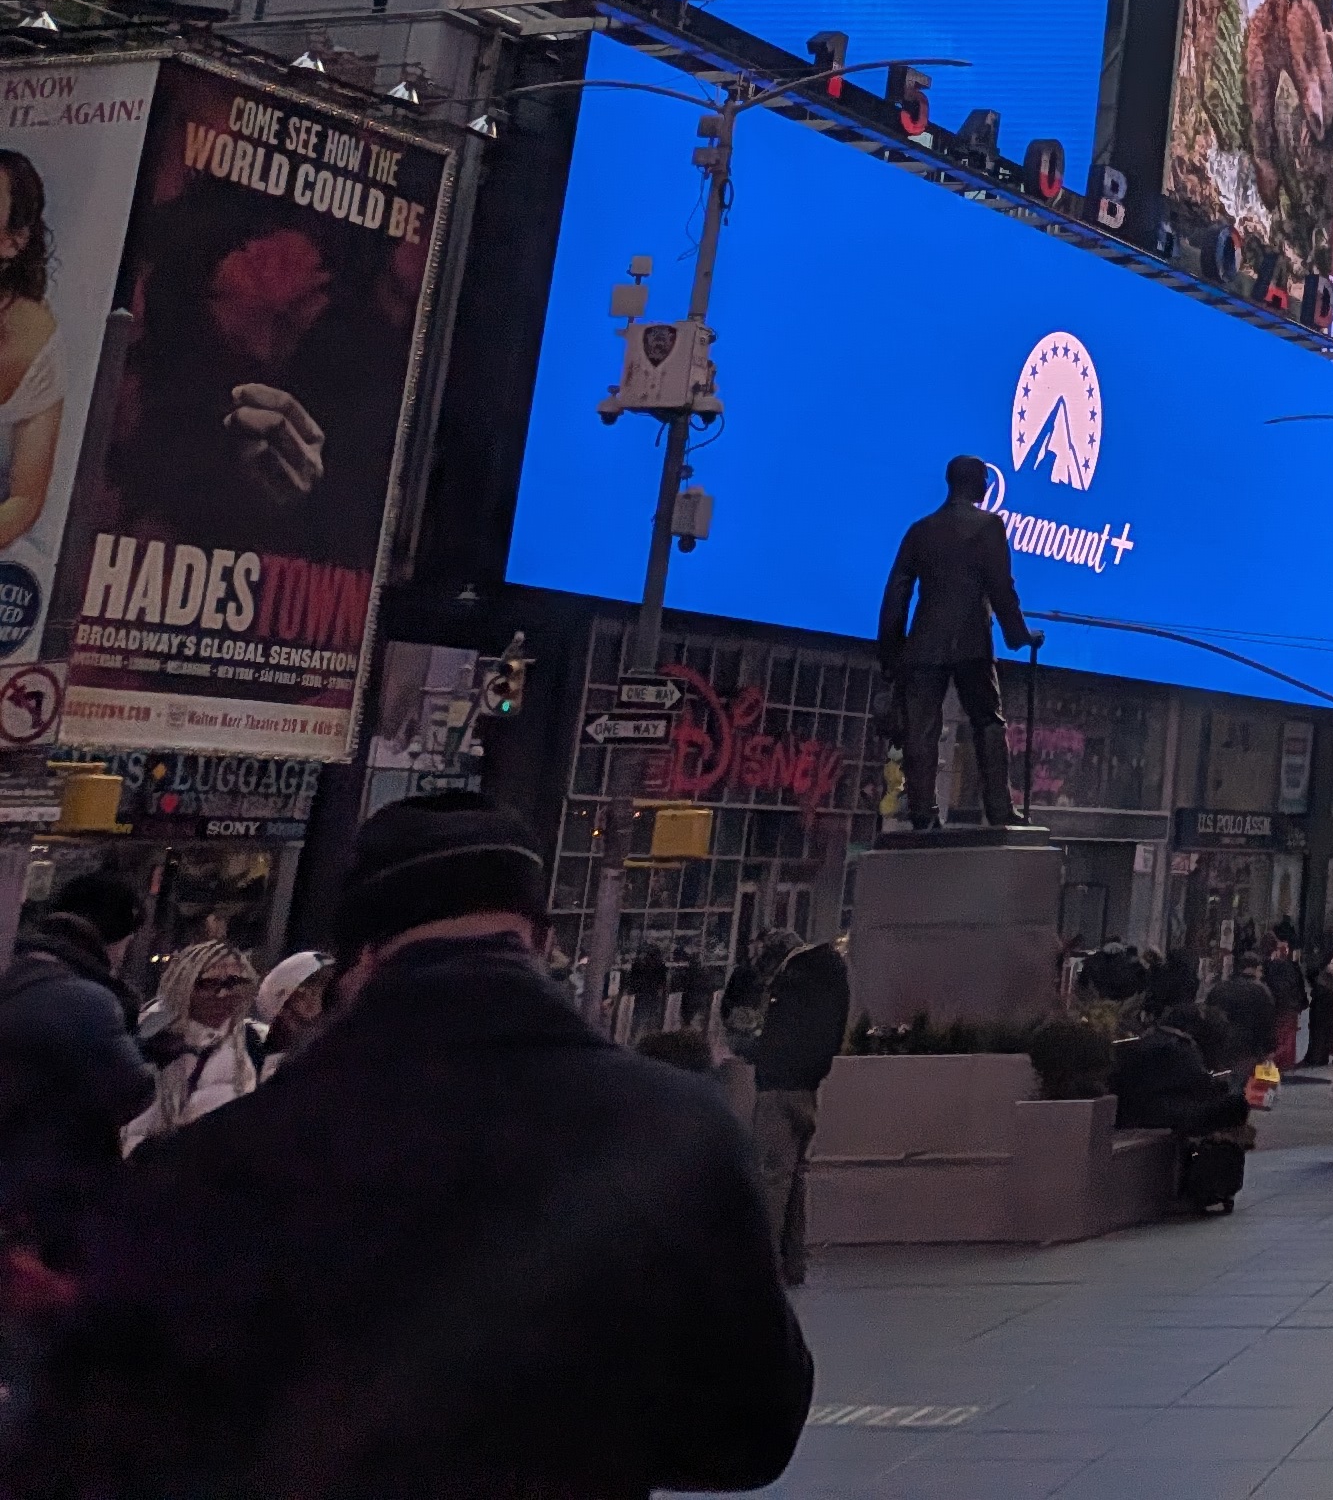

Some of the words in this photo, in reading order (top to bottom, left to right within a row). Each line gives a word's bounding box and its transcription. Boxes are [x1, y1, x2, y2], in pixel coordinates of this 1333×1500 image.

[4, 77, 77, 100] KNOW
[59, 100, 144, 126] AGAIN!
[229, 96, 281, 145] COME
[285, 116, 323, 160] SEE
[324, 128, 365, 173] HOW
[369, 142, 402, 188] THE
[184, 121, 290, 197] WORLD
[294, 164, 386, 230] COULD
[389, 198, 425, 244] BE
[81, 533, 373, 649] HADESTOWN
[76, 623, 197, 657] BROADWAY'S
[200, 638, 265, 665] GLOBAL
[270, 645, 357, 672] SENSATION
[627, 687, 648, 701] ONE
[653, 687, 676, 701] WAY
[220, 713, 242, 729] Kerr
[245, 715, 280, 732] Theatre
[595, 721, 619, 737] ONE
[633, 721, 659, 736] WAY
[173, 754, 322, 797] LUGGAGE
[207, 821, 260, 836] SONY
[1216, 814, 1243, 834] POLO
